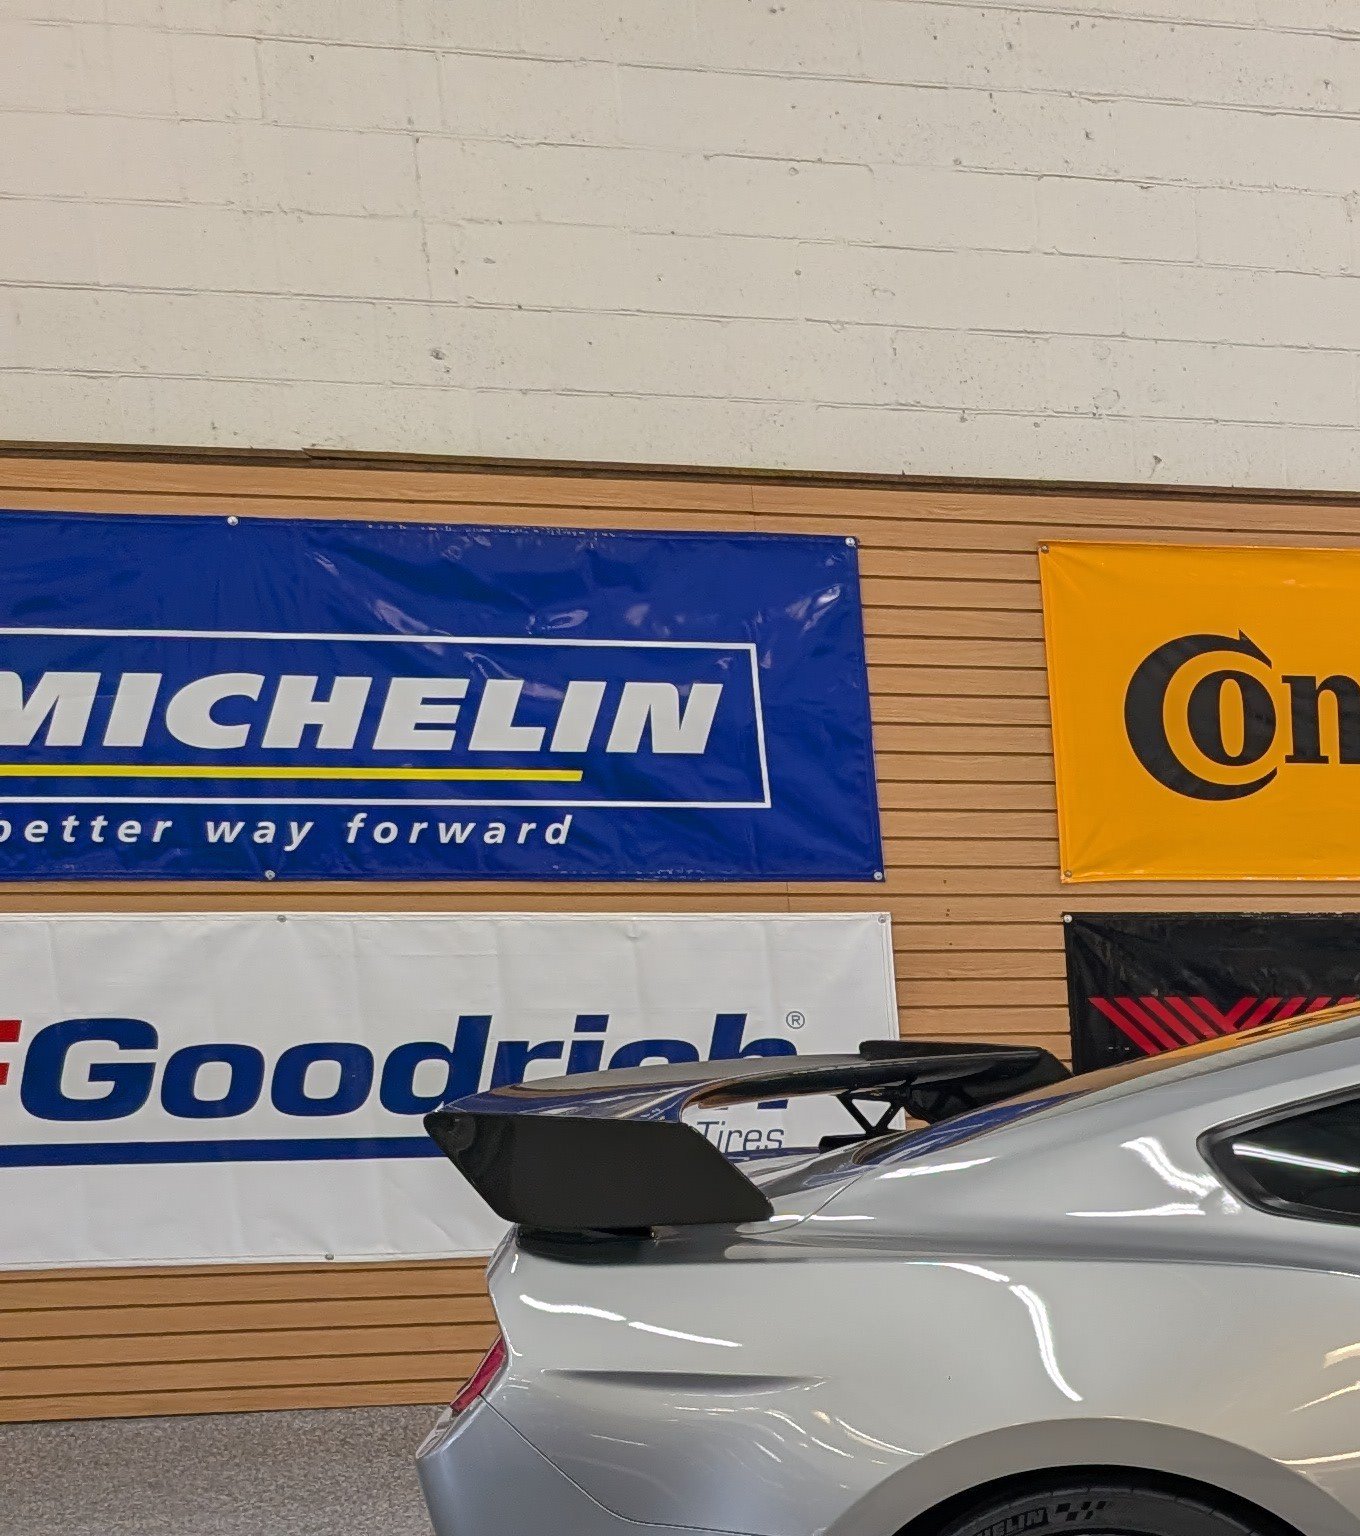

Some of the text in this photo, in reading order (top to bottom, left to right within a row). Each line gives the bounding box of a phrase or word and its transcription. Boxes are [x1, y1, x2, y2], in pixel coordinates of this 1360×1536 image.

[0, 671, 724, 755] MICHELIN
[206, 820, 314, 852] way
[346, 812, 573, 845] forward
